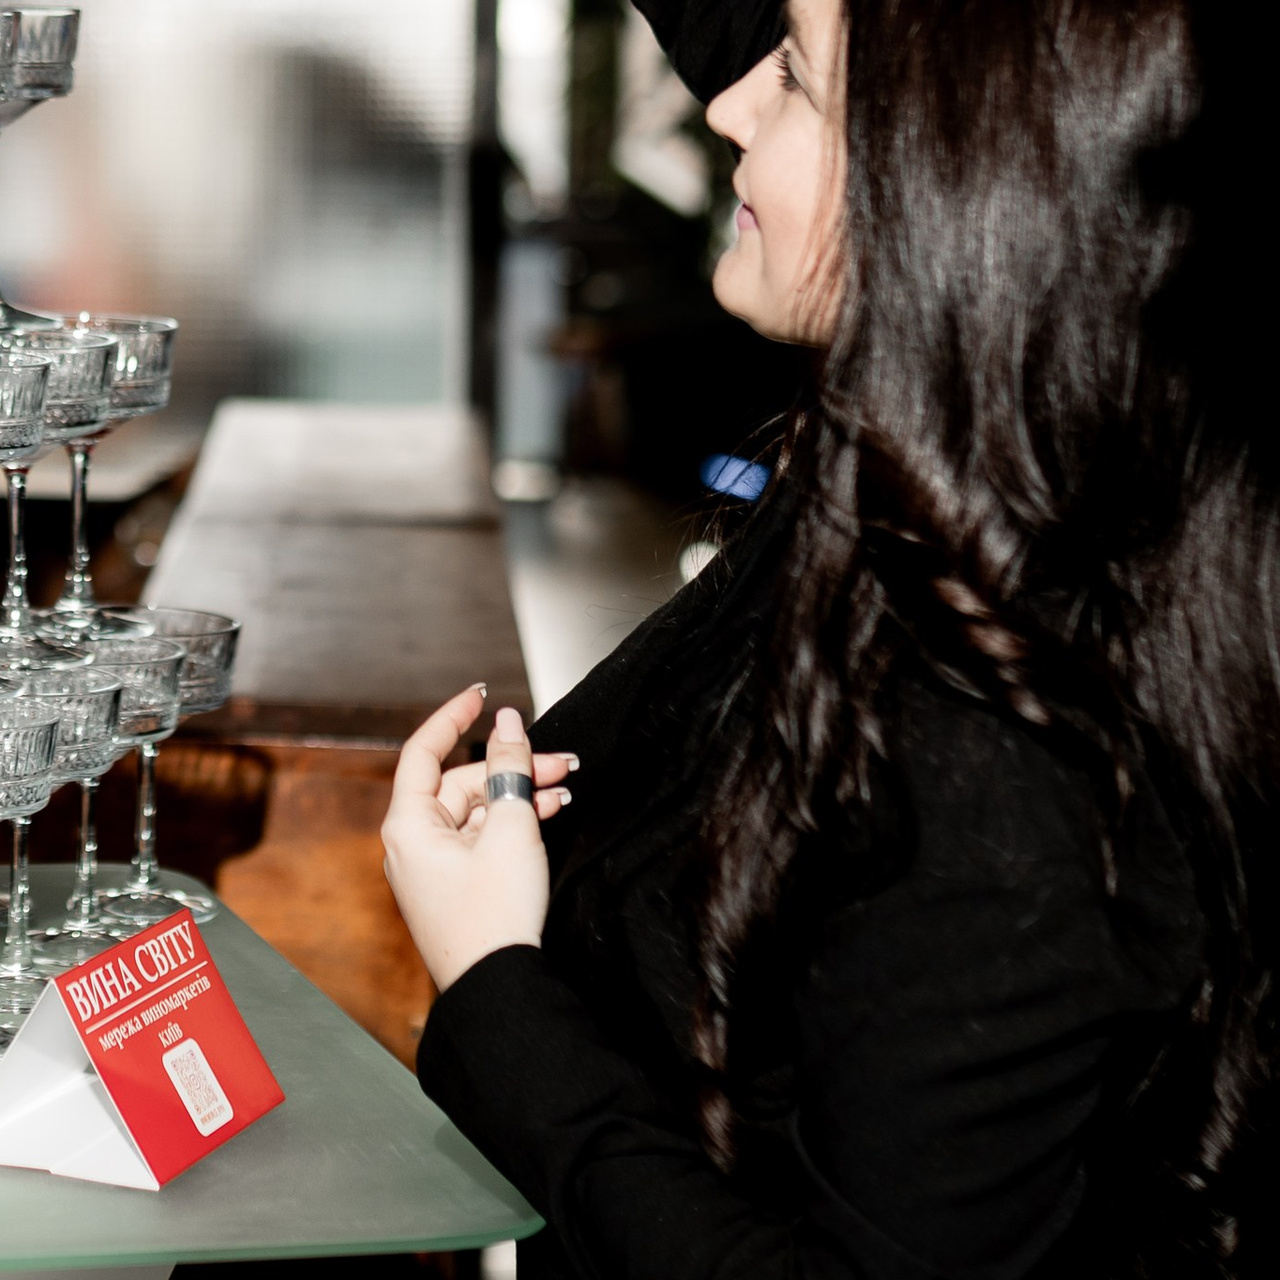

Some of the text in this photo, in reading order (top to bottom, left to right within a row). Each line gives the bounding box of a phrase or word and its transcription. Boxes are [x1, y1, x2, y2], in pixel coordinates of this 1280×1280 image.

[66, 920, 195, 1022] ВИНА СВІТУ
[98, 973, 211, 1052] мережа виномаркетів
